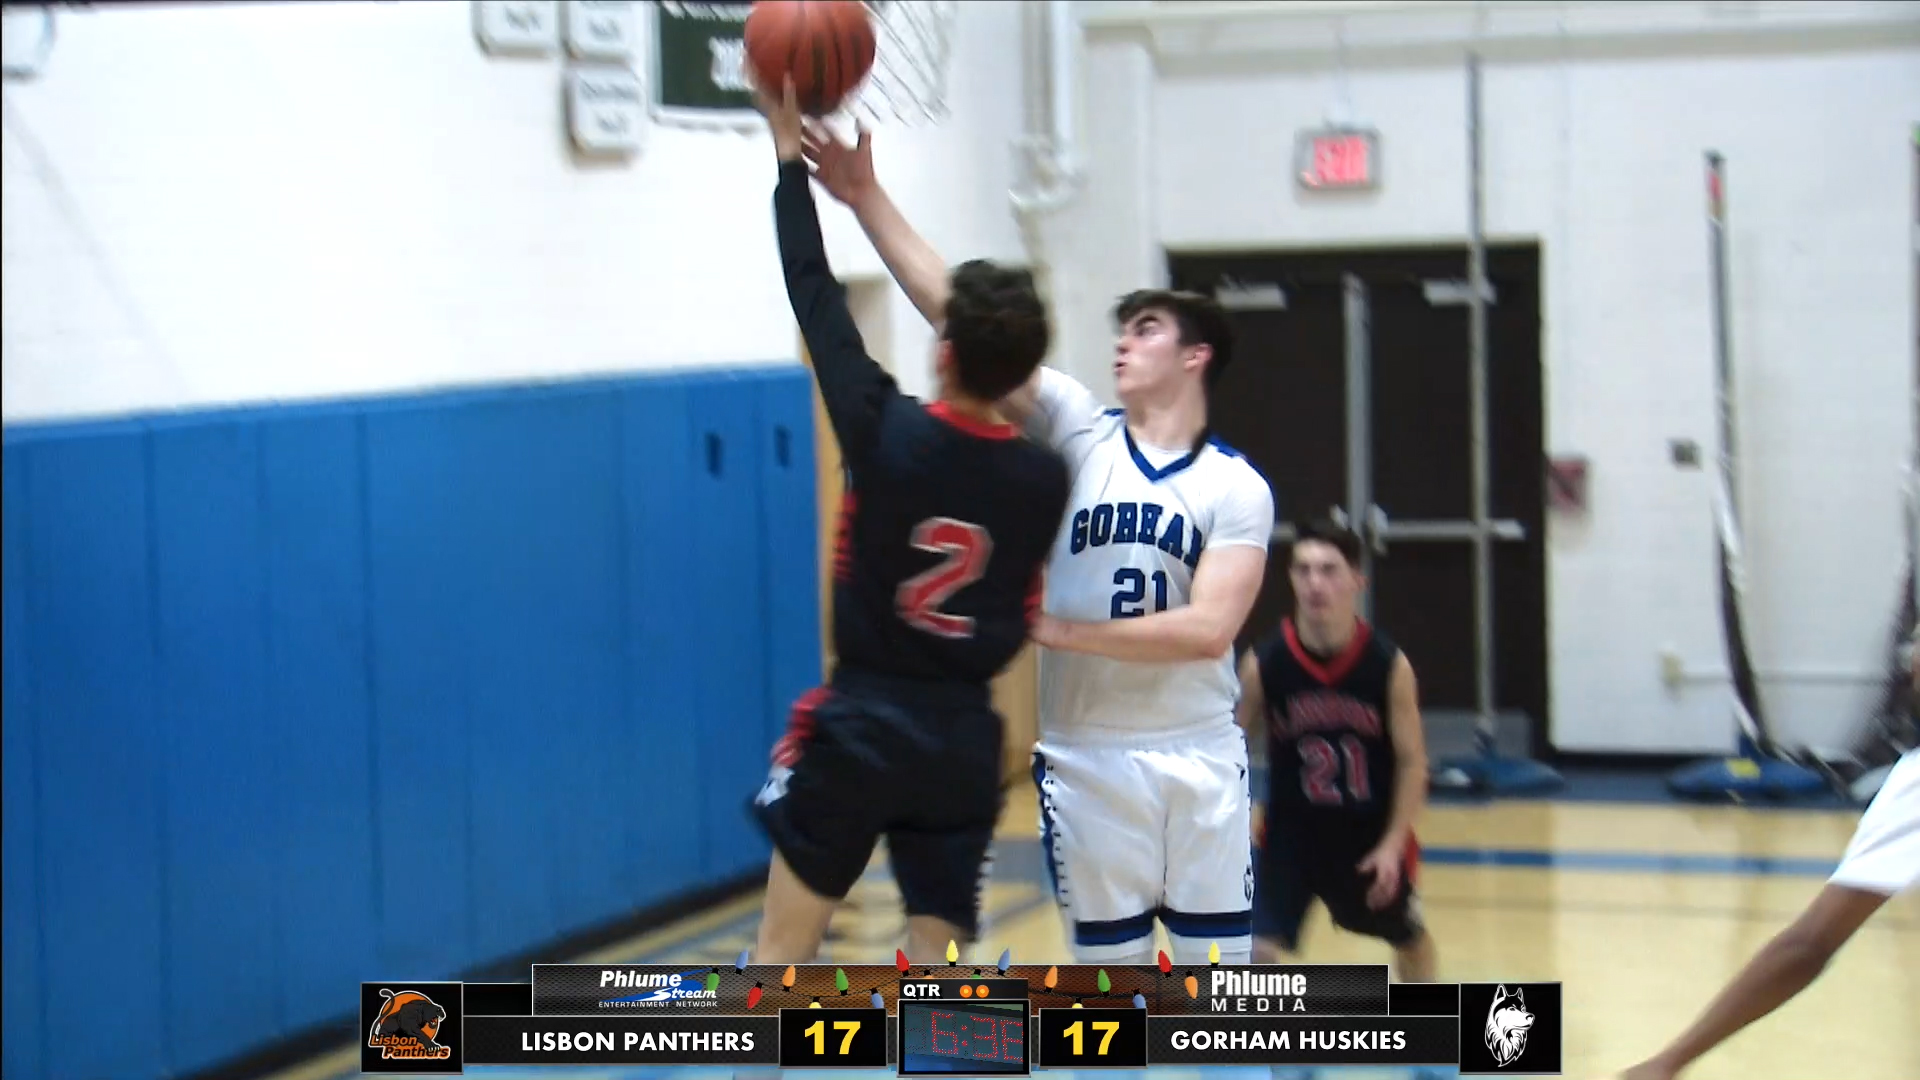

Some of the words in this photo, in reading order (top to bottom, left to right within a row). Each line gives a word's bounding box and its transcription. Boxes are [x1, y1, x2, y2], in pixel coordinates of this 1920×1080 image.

[895, 516, 994, 638] 2
[1110, 568, 1168, 619] 21
[1298, 735, 1371, 804] 21
